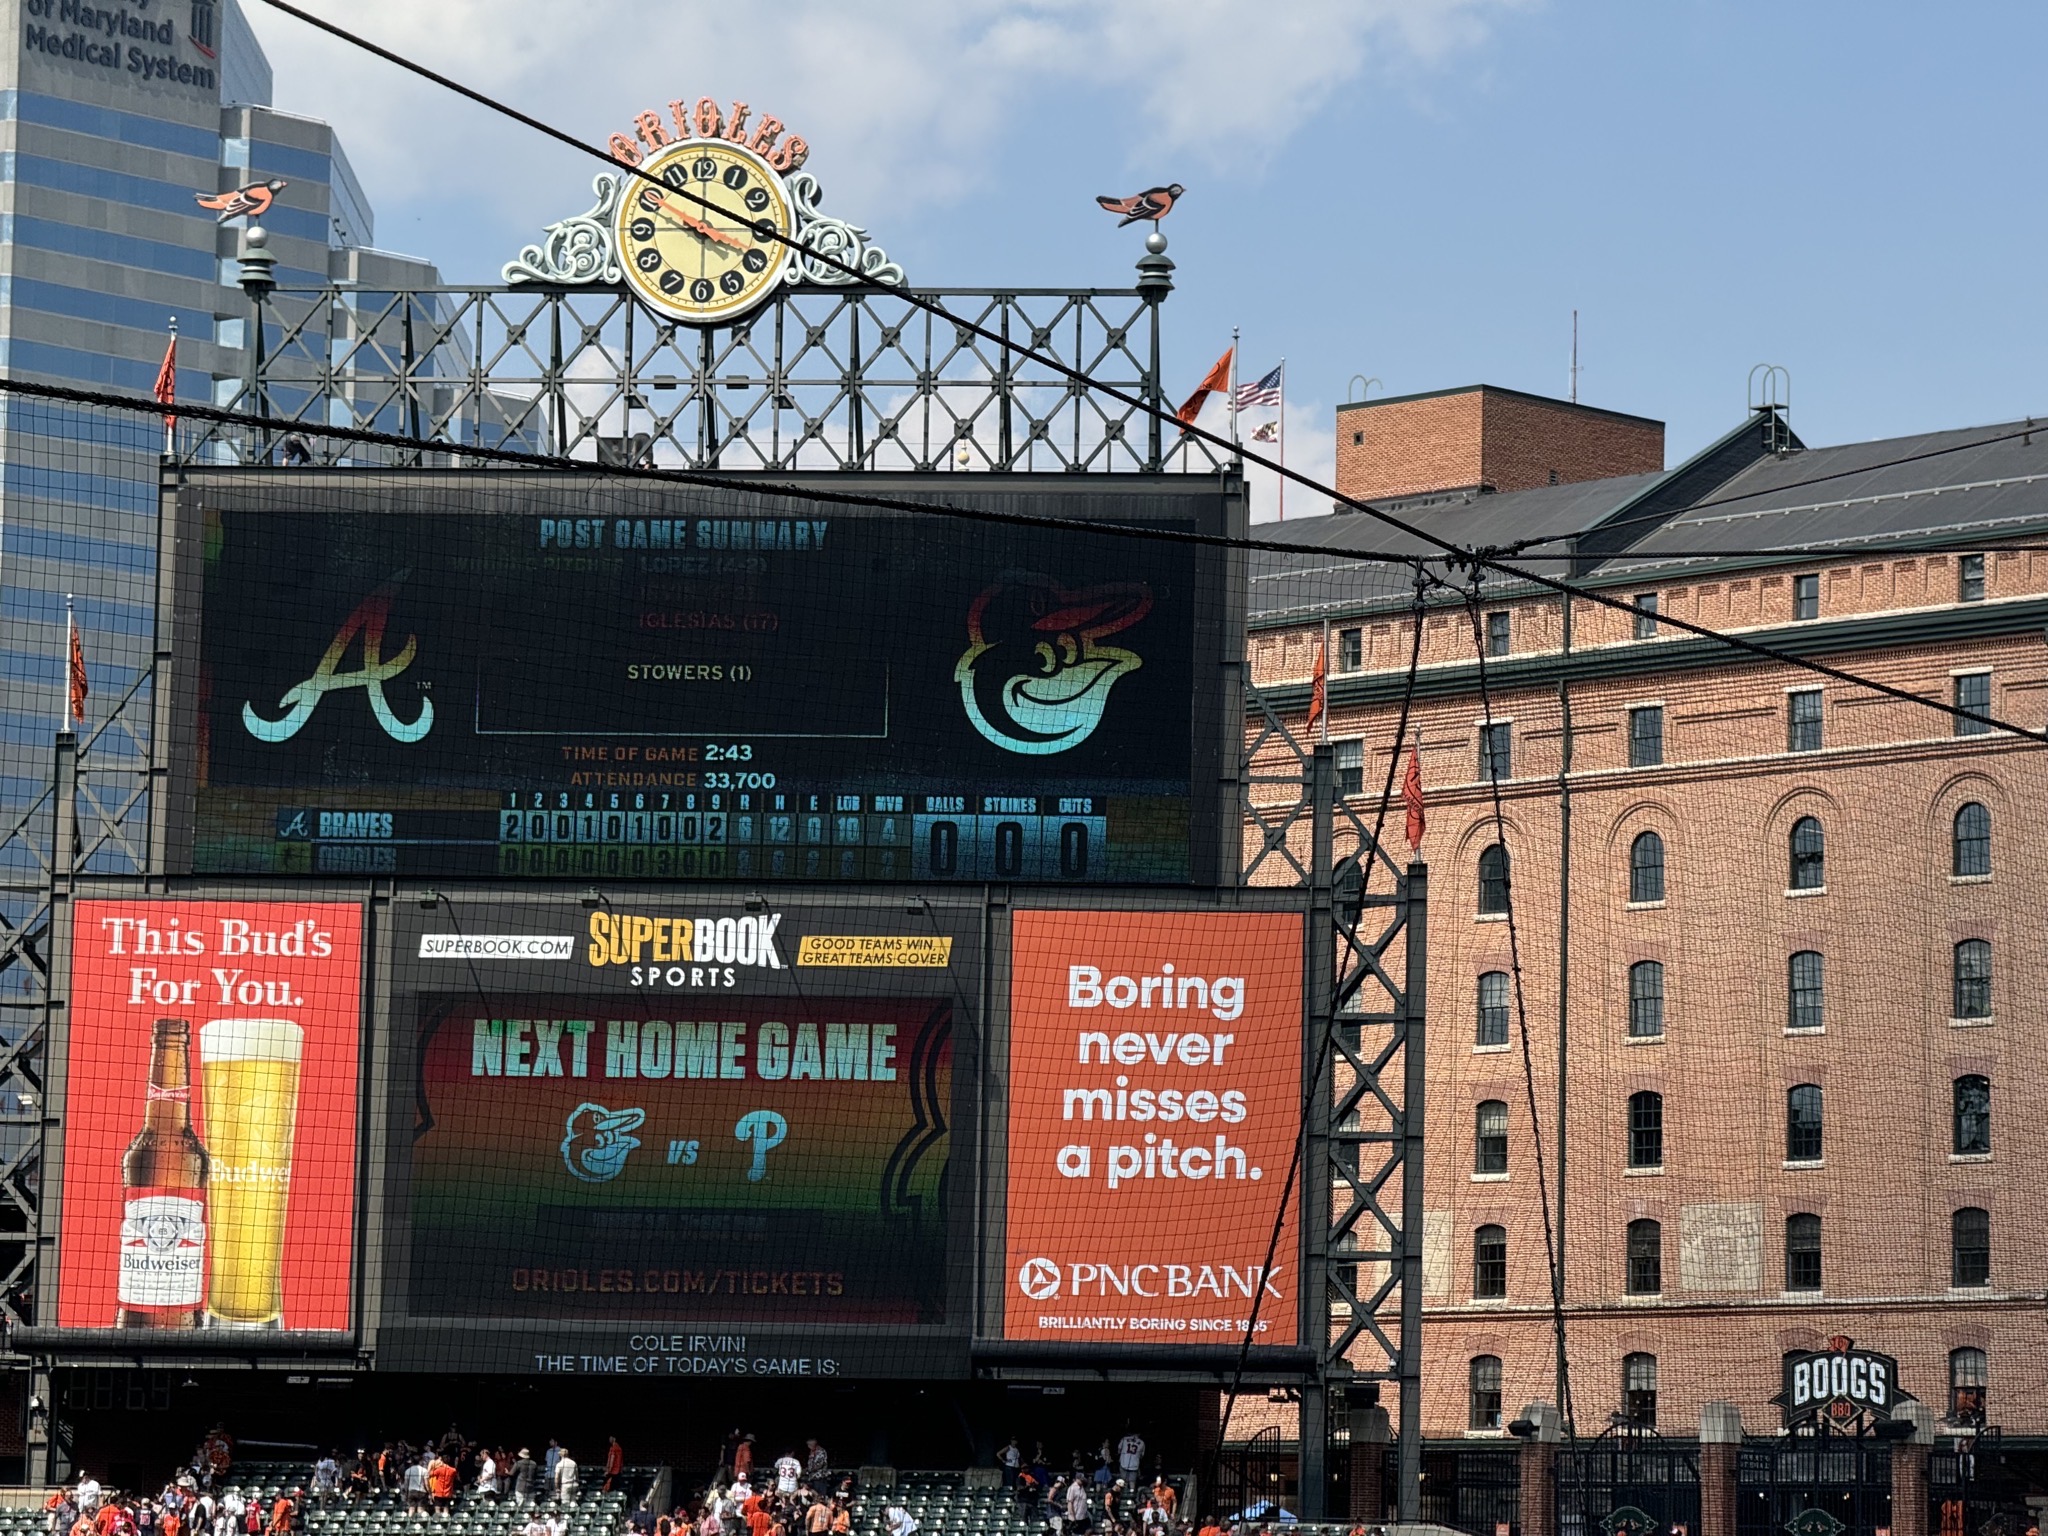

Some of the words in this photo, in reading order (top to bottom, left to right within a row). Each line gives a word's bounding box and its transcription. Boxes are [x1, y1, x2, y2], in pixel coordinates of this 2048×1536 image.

[28, 0, 50, 18] of
[60, 0, 174, 45] Maryland
[26, 24, 121, 69] Medical
[127, 46, 215, 90] System
[608, 96, 808, 171] ORIOLES
[665, 166, 687, 187] 11
[696, 160, 715, 179] 12
[729, 169, 742, 188] 1
[746, 191, 766, 208] 2
[633, 224, 652, 237] 9
[640, 255, 659, 268] 8
[748, 254, 764, 270] 4
[664, 273, 682, 290] 7
[694, 280, 707, 300] 6
[726, 273, 740, 292] 5
[540, 519, 605, 549] POST
[615, 519, 686, 550] GAME
[696, 520, 828, 551] SUMMARY
[640, 556, 709, 574] LOPEZ
[638, 612, 736, 629] IGLESIAS
[742, 613, 780, 632] (17)
[627, 664, 723, 681] STOWERS
[729, 665, 752, 683] (1)
[562, 746, 608, 761] TIME
[614, 746, 639, 761] OF
[645, 747, 699, 762] GAME
[704, 744, 753, 762] 2:43
[571, 771, 697, 787] ATTENDANCE
[703, 772, 776, 791] 33,700
[510, 792, 517, 808] 1
[534, 792, 544, 808] 2
[559, 792, 569, 808] 3
[584, 793, 594, 809] 4
[610, 793, 619, 809] 5
[635, 793, 645, 809] 6
[661, 793, 670, 810] 7
[686, 793, 696, 810] 8
[711, 794, 721, 810] 9
[739, 794, 750, 811] R
[775, 794, 785, 811] H
[810, 795, 819, 811] E
[836, 795, 860, 812] LOB
[926, 796, 965, 813] BALLS
[984, 796, 1037, 813] STRIKES
[1058, 797, 1093, 814] OUTS
[319, 812, 393, 838] BRAVES
[506, 815, 518, 838] 2
[532, 815, 544, 838] 0
[558, 815, 569, 838] 0
[584, 816, 592, 839] 1
[608, 816, 620, 839] 0
[635, 816, 643, 839] 1
[659, 816, 670, 840] 0
[684, 816, 696, 840] 0
[709, 817, 721, 840] 2
[769, 816, 790, 841] 12
[807, 817, 821, 842] 0
[837, 817, 859, 842] 10
[931, 821, 957, 876] 0
[996, 821, 1022, 876] 0
[1061, 822, 1088, 877] 0
[102, 917, 205, 956] This
[218, 918, 333, 957] Bud's
[425, 939, 569, 955] SUPERBOOK.COM
[588, 911, 782, 969] SUPERBOOK
[810, 938, 856, 950] GOOD
[860, 938, 903, 950] TEAMS
[907, 939, 936, 952] WIN,
[802, 952, 846, 964] GREAT
[849, 952, 893, 964] TEAMS
[897, 952, 945, 965] COVER
[127, 967, 202, 1005] For
[211, 968, 304, 1006] You.
[630, 966, 736, 988] SPORTS
[1068, 963, 1245, 1021] Boring
[471, 1019, 596, 1077] NEXT
[606, 1020, 747, 1079] HOME
[757, 1022, 898, 1081] GAME
[1078, 1031, 1234, 1066] never
[1062, 1075, 1247, 1122] misses
[1056, 1144, 1090, 1178] a
[1108, 1132, 1263, 1189] pitch.
[123, 1252, 201, 1271] Budweiser
[512, 1268, 845, 1296] ORIOLES.COM/TICKETS
[1067, 1263, 1159, 1298] PNC
[1163, 1264, 1283, 1299] BANK
[1038, 1316, 1127, 1330] BRILLIANTLY
[1129, 1317, 1186, 1331] BORING
[1190, 1318, 1233, 1332] SINCE
[630, 1335, 683, 1351] COLE
[689, 1335, 746, 1352] IRVIN!
[535, 1355, 575, 1372] THE
[580, 1355, 628, 1373] TIME
[633, 1356, 659, 1373] OF
[665, 1356, 748, 1374] TODAY'S
[752, 1358, 811, 1375] GAME
[1794, 1356, 1886, 1406] BOOG'S
[1830, 1402, 1851, 1418] BBQ
[780, 1466, 796, 1479] 33
